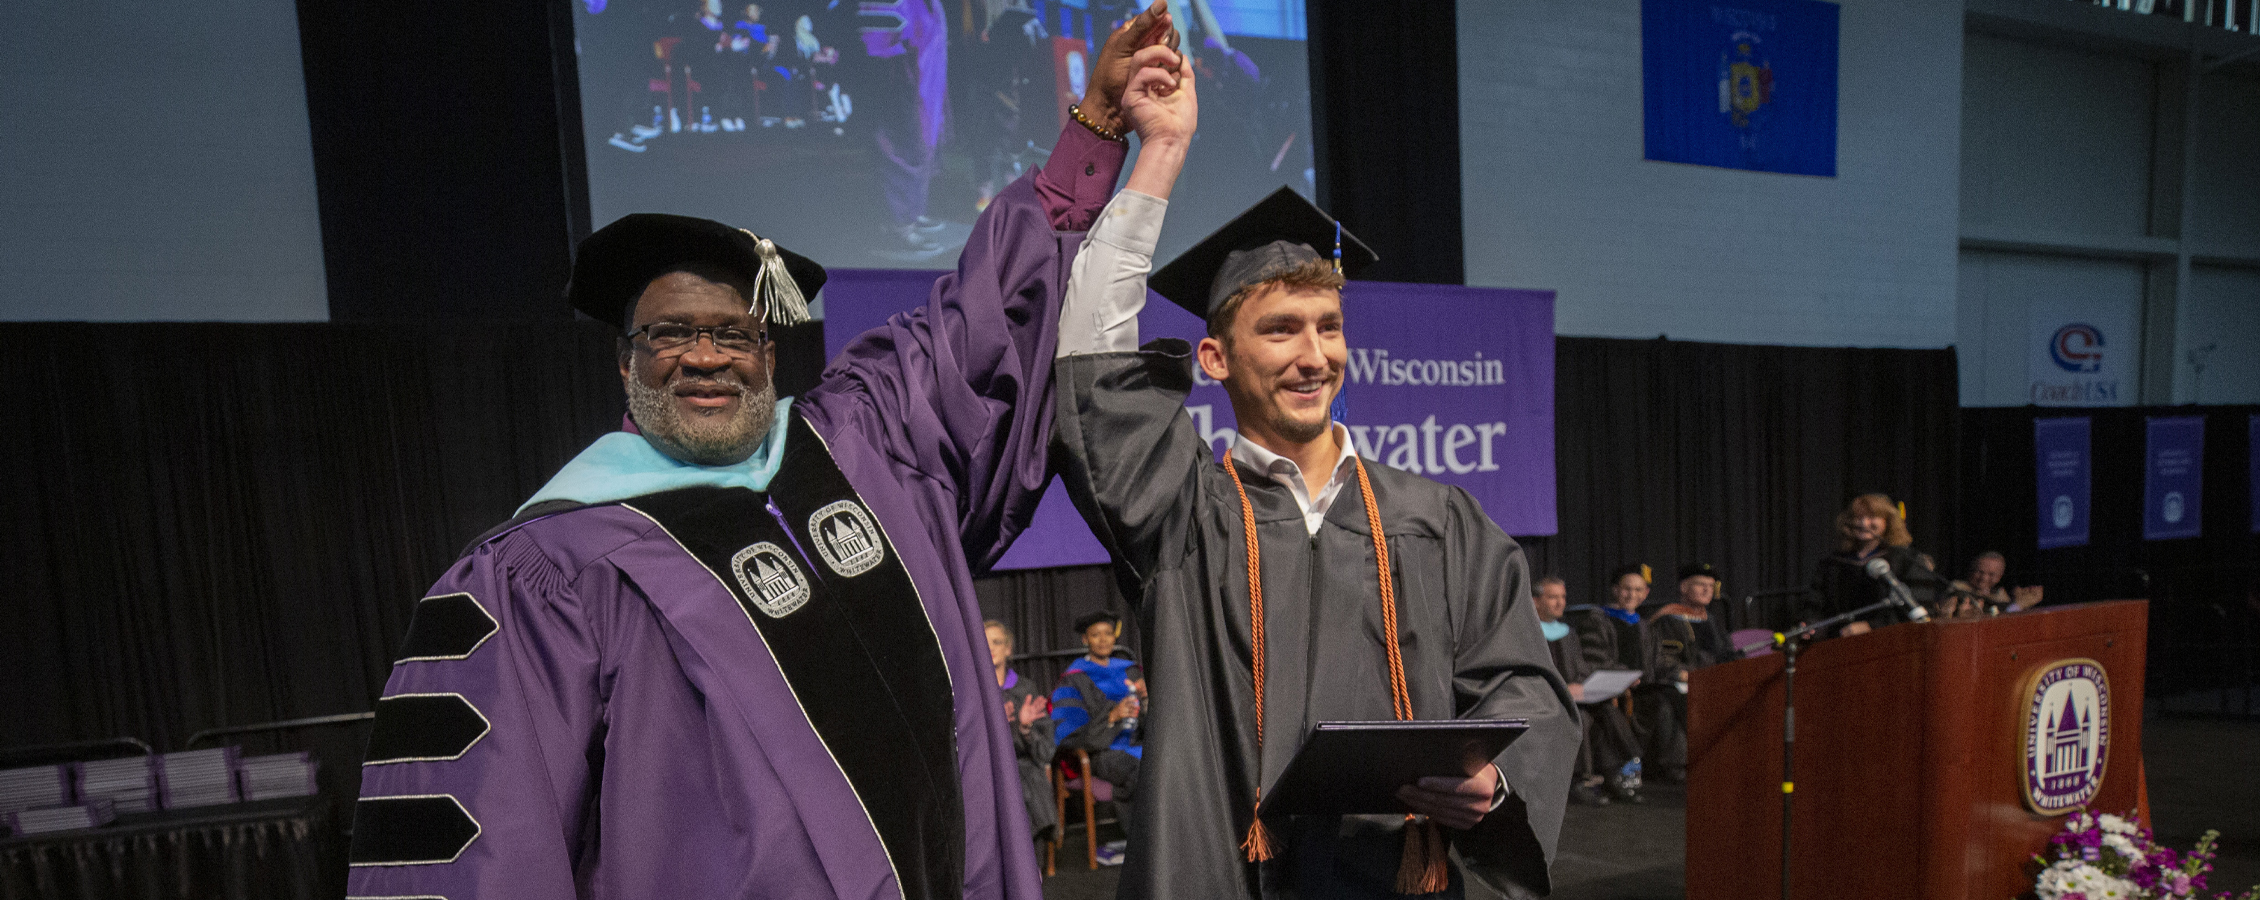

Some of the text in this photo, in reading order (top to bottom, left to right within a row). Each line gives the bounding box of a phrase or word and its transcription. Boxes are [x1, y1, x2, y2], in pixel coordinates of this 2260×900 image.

[1346, 348, 1505, 386] Wisconsin
[837, 502, 874, 535] WISCONSIN
[758, 544, 798, 574] WISCONSIN
[839, 549, 882, 574] WHITEWATER
[767, 587, 808, 615] WHITEWATER
[2028, 665, 2108, 758] UNIVERSITY OF WISCONSIN
[2033, 777, 2099, 809] WHITEWATER
